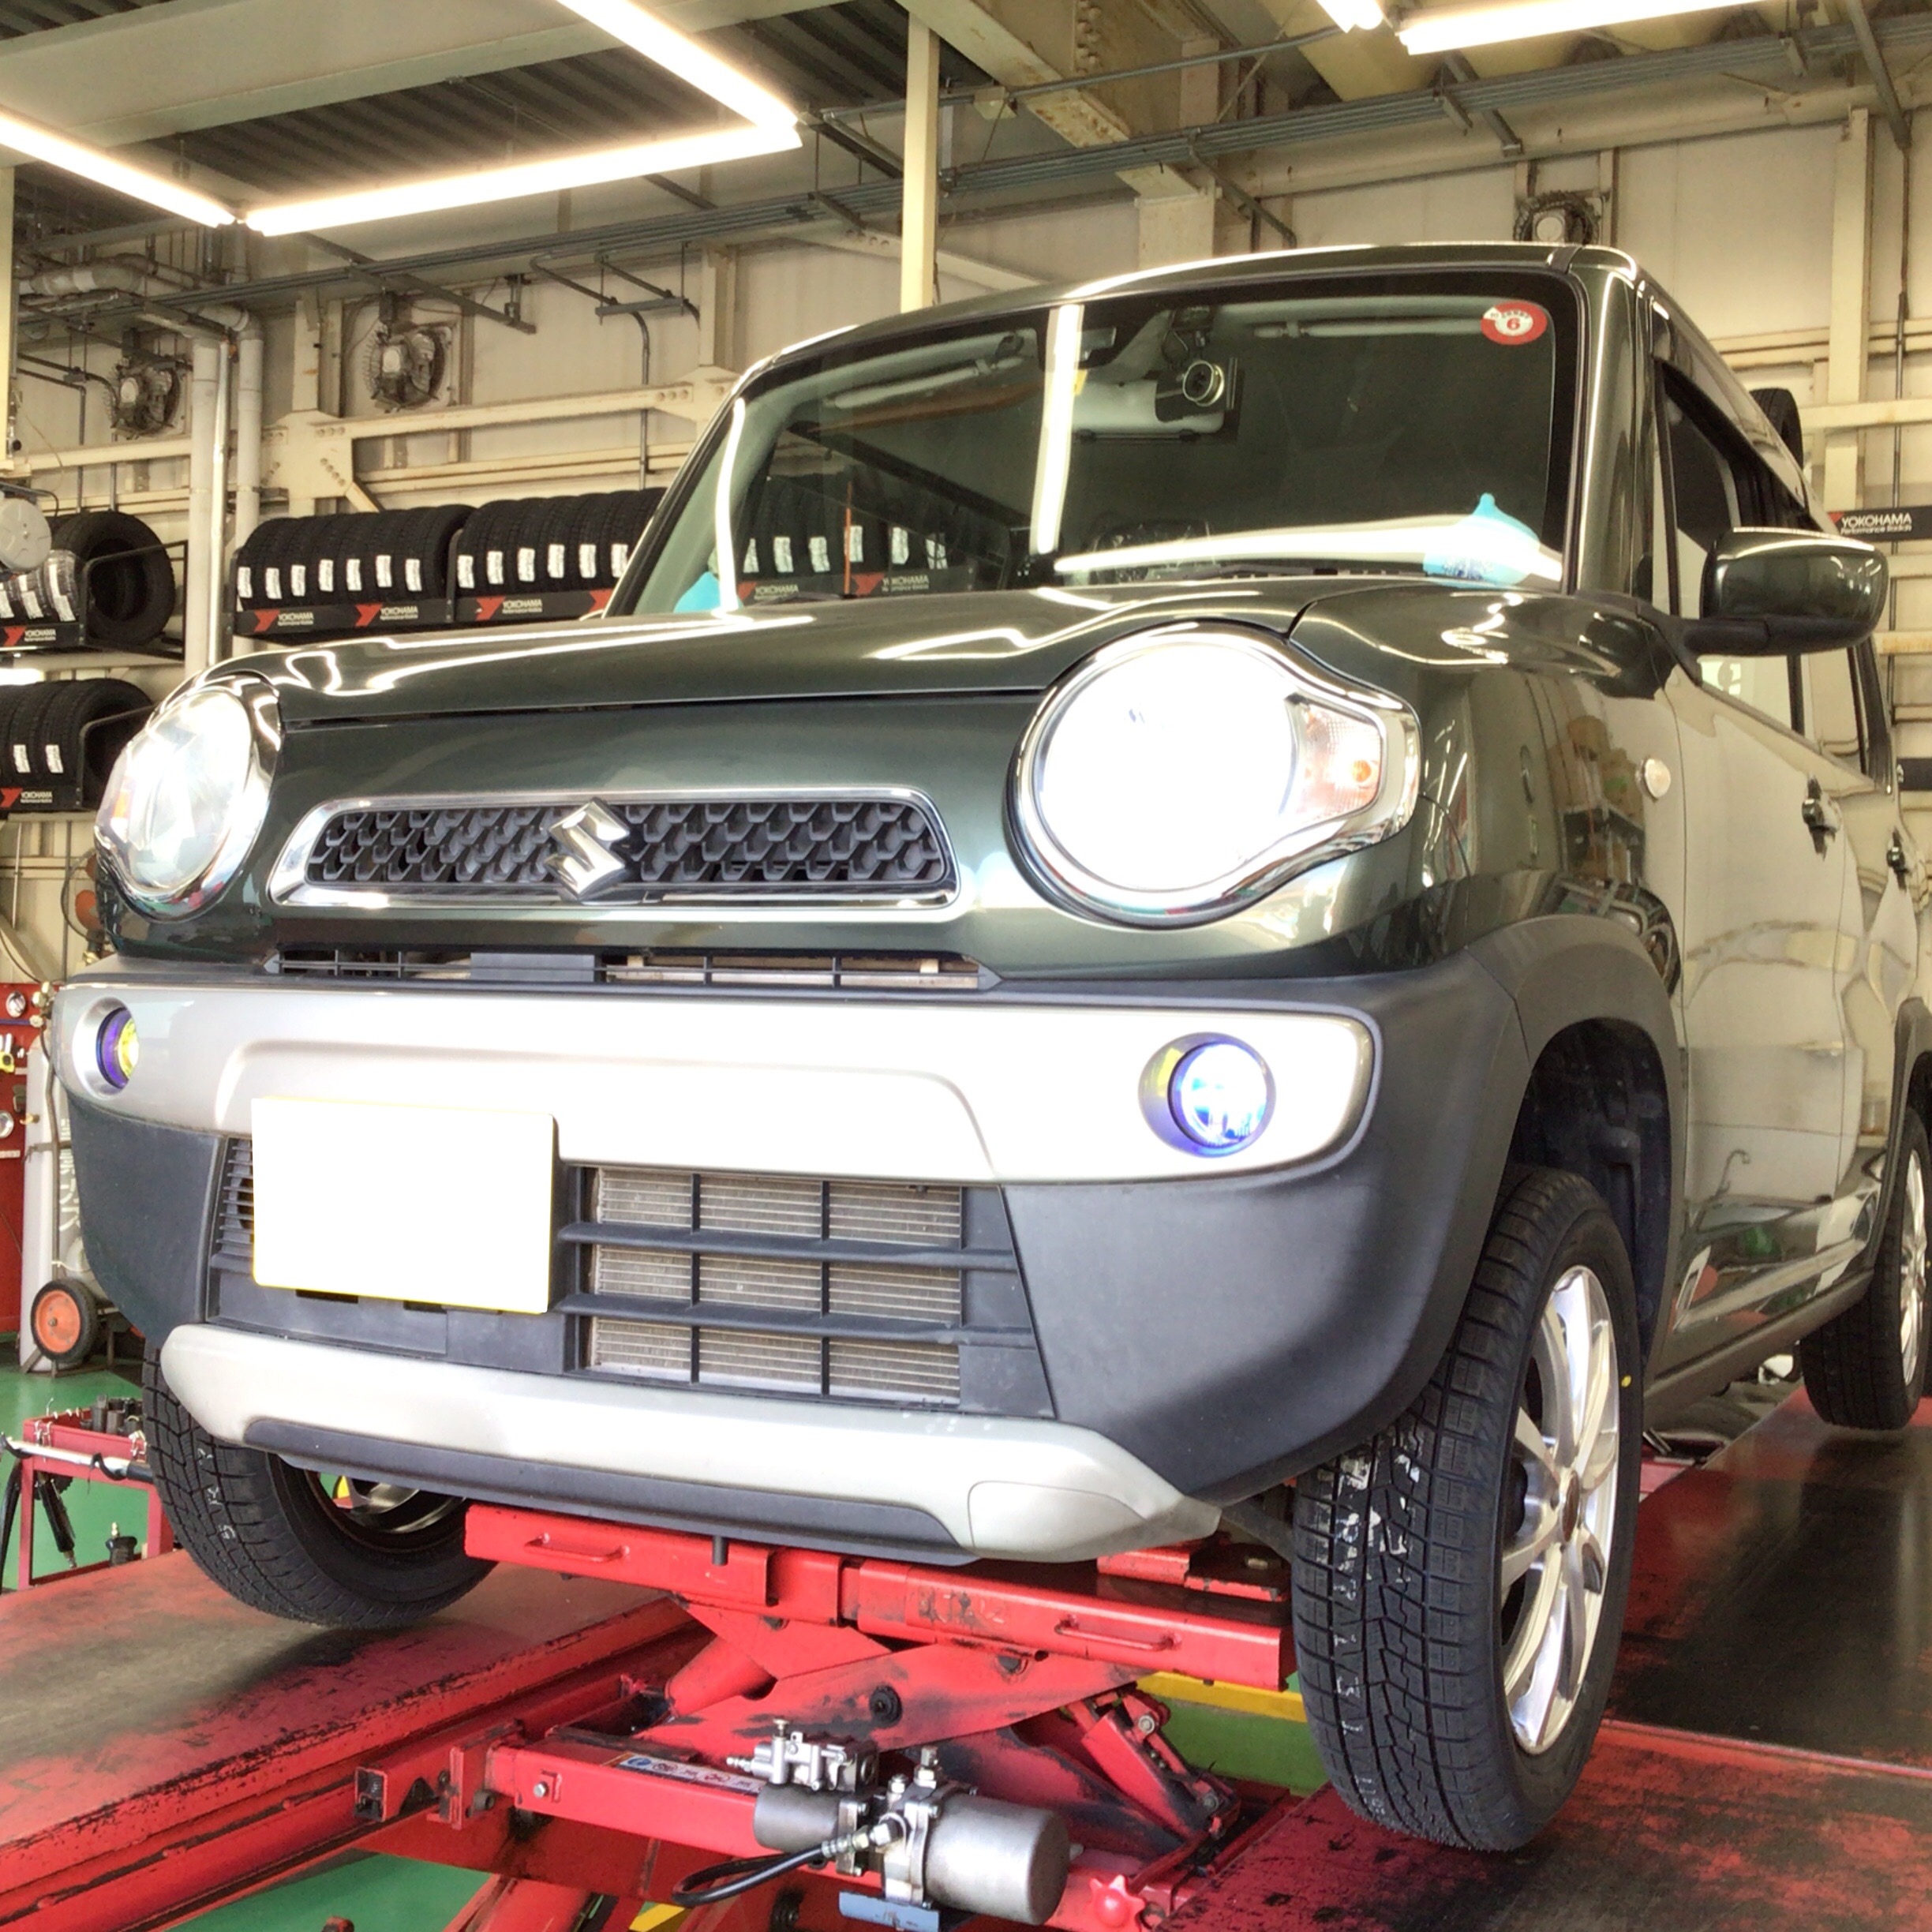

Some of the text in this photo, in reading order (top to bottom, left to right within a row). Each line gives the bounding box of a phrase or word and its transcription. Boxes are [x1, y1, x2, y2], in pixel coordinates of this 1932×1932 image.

[1841, 512, 1912, 529] YOKOHAMA
[754, 584, 799, 595] YOKOHAMA
[502, 598, 543, 608] YOKOHAMA
[380, 605, 418, 616] YOKOHAMA
[278, 612, 314, 621] YOKOHAMA
[24, 628, 56, 638] YOKOHAMA
[21, 791, 53, 799] YOKOHAMA
